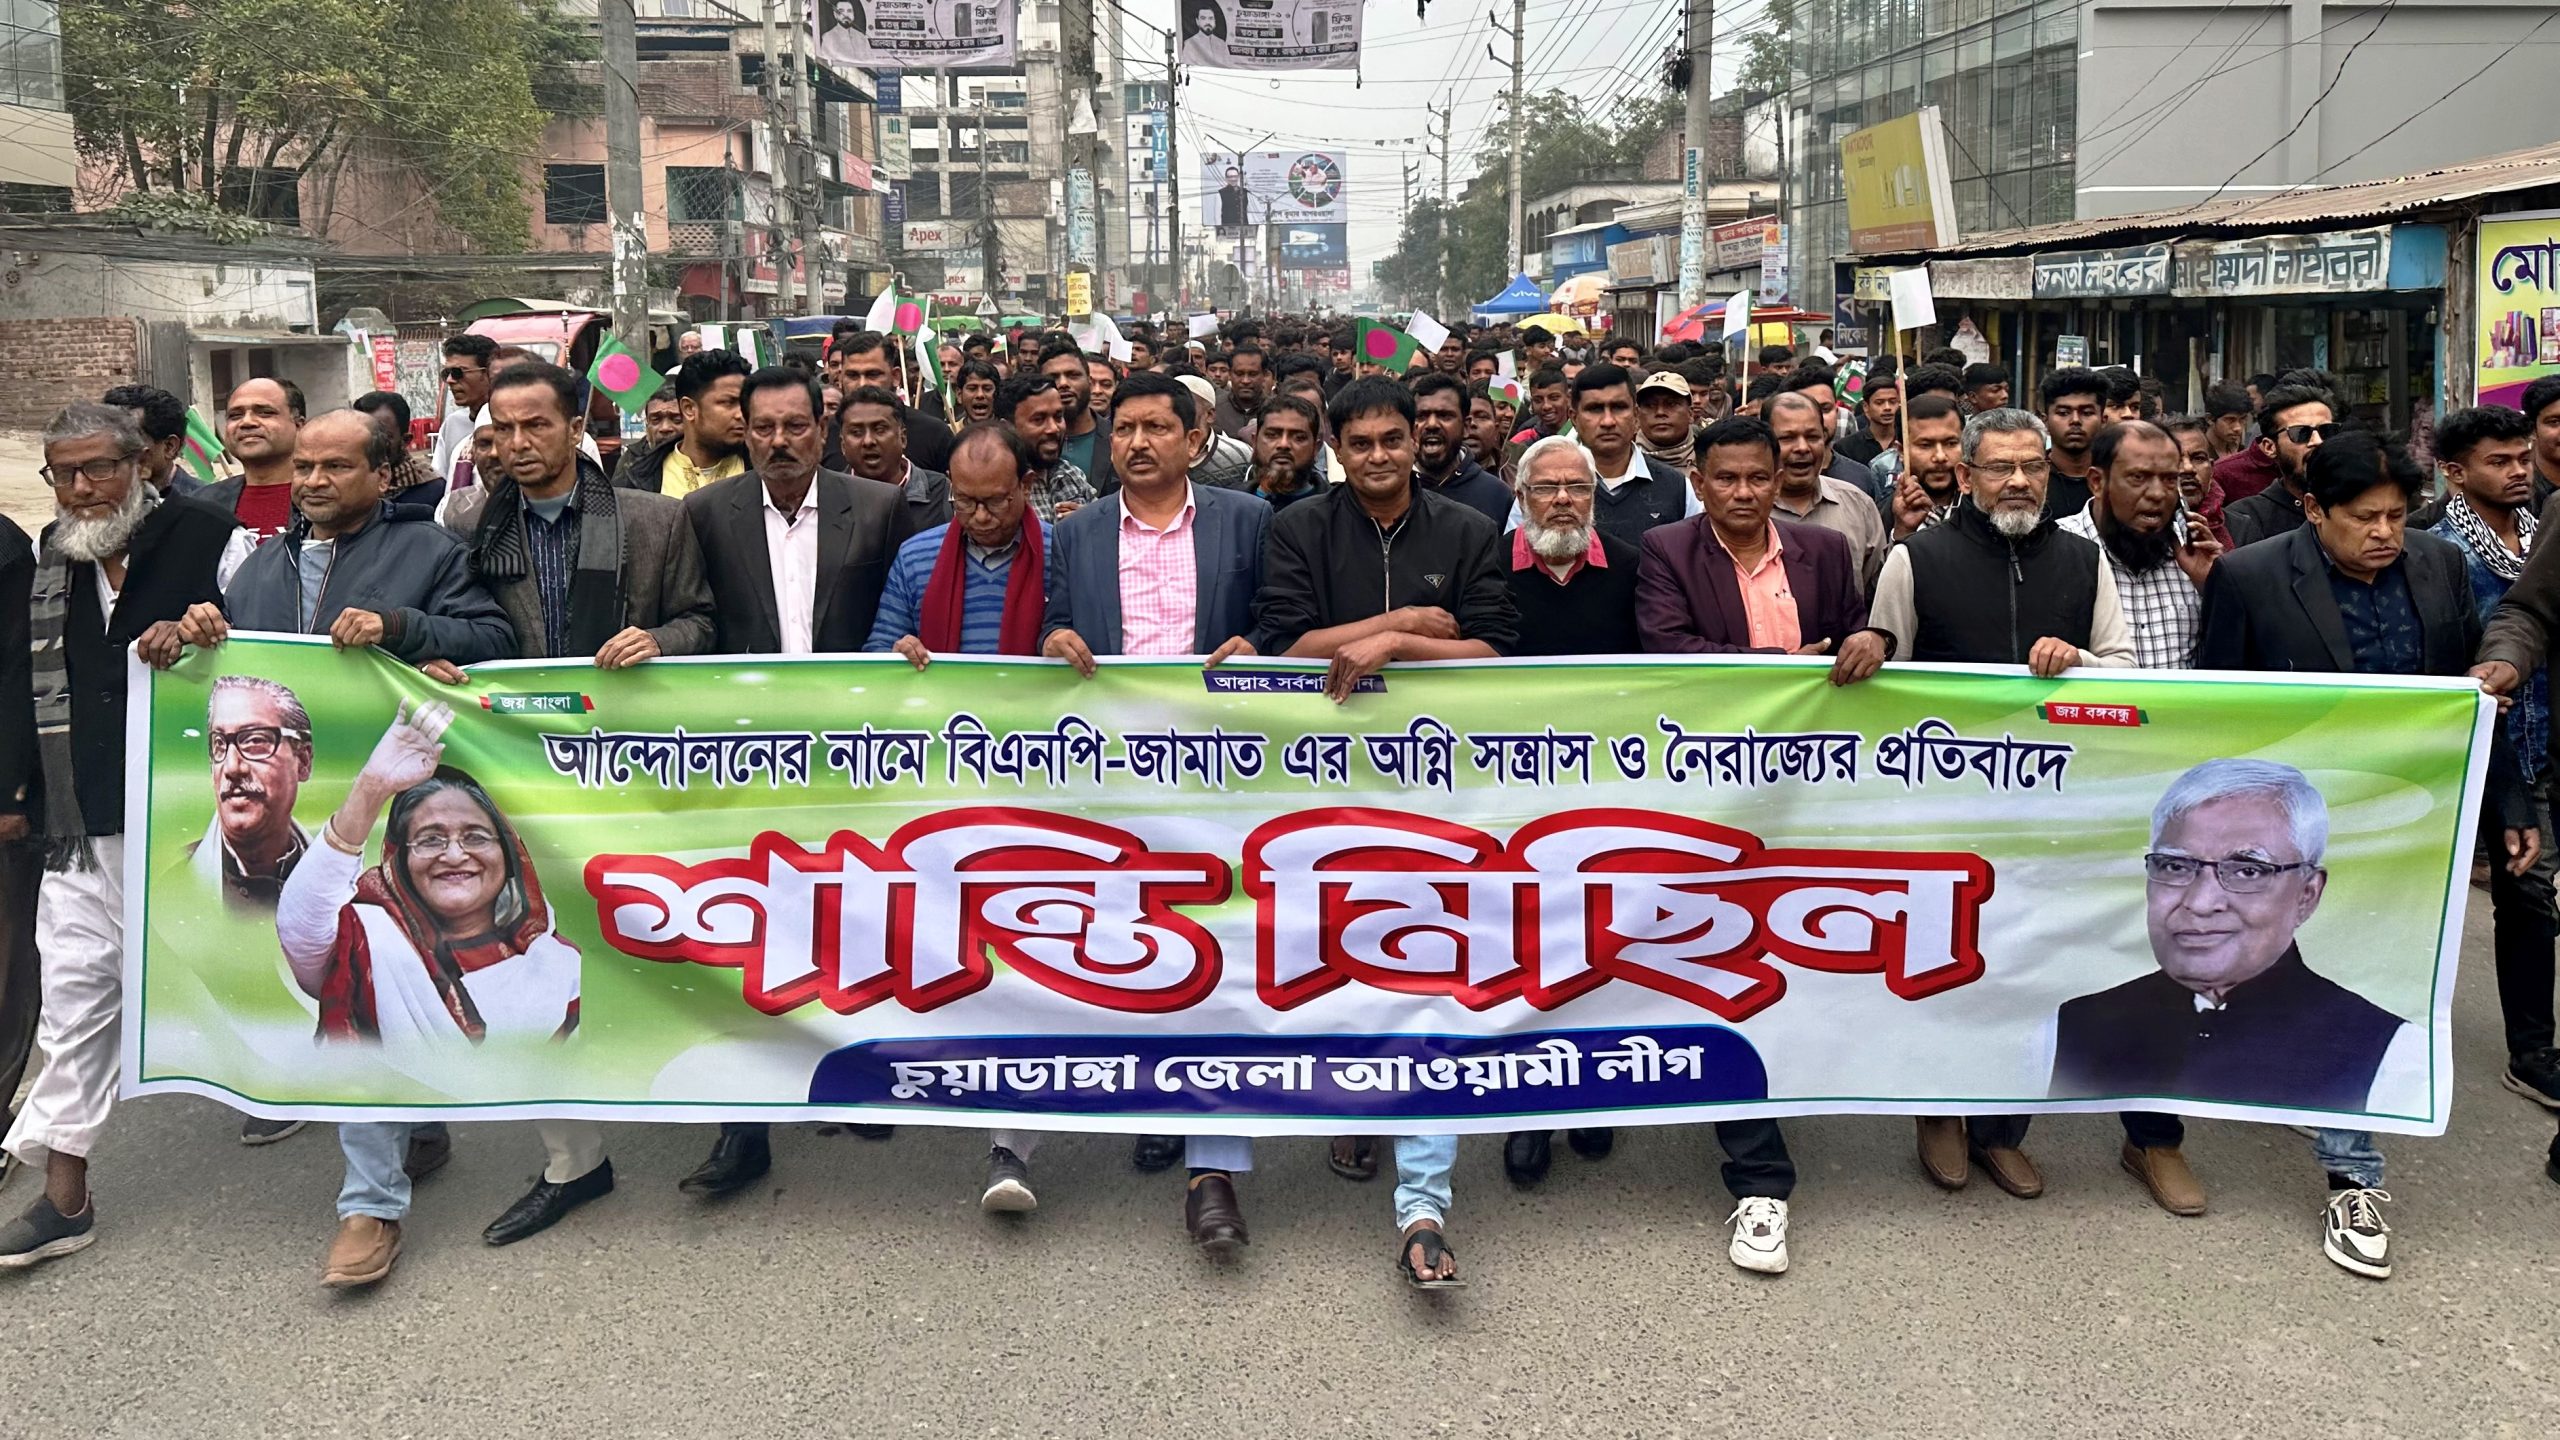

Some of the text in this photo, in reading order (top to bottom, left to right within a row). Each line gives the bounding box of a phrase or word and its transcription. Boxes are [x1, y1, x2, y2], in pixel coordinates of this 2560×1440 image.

[909, 227, 942, 243] Apex
[2035, 255, 2083, 291] জনতা
[2085, 246, 2169, 290] লাইব্রেরী
[2491, 236, 2560, 292] মো
[500, 691, 571, 712] জয় বাংলা
[1214, 675, 1271, 691] আল্লাহ
[2055, 704, 2132, 727] জয় বঙ্গবন্ধু
[541, 714, 2072, 791] আন্দোলনের নামে বিএনপি-জামাত এর অগ্নি সন্ত্রাস ও নৈরাজ্যের প্রতিবাদে
[588, 808, 1990, 1018] শান্তি মিছিল
[891, 1034, 1705, 1099] চুয়াডাঙ্গা জেলা আওয়ামী লীগ
